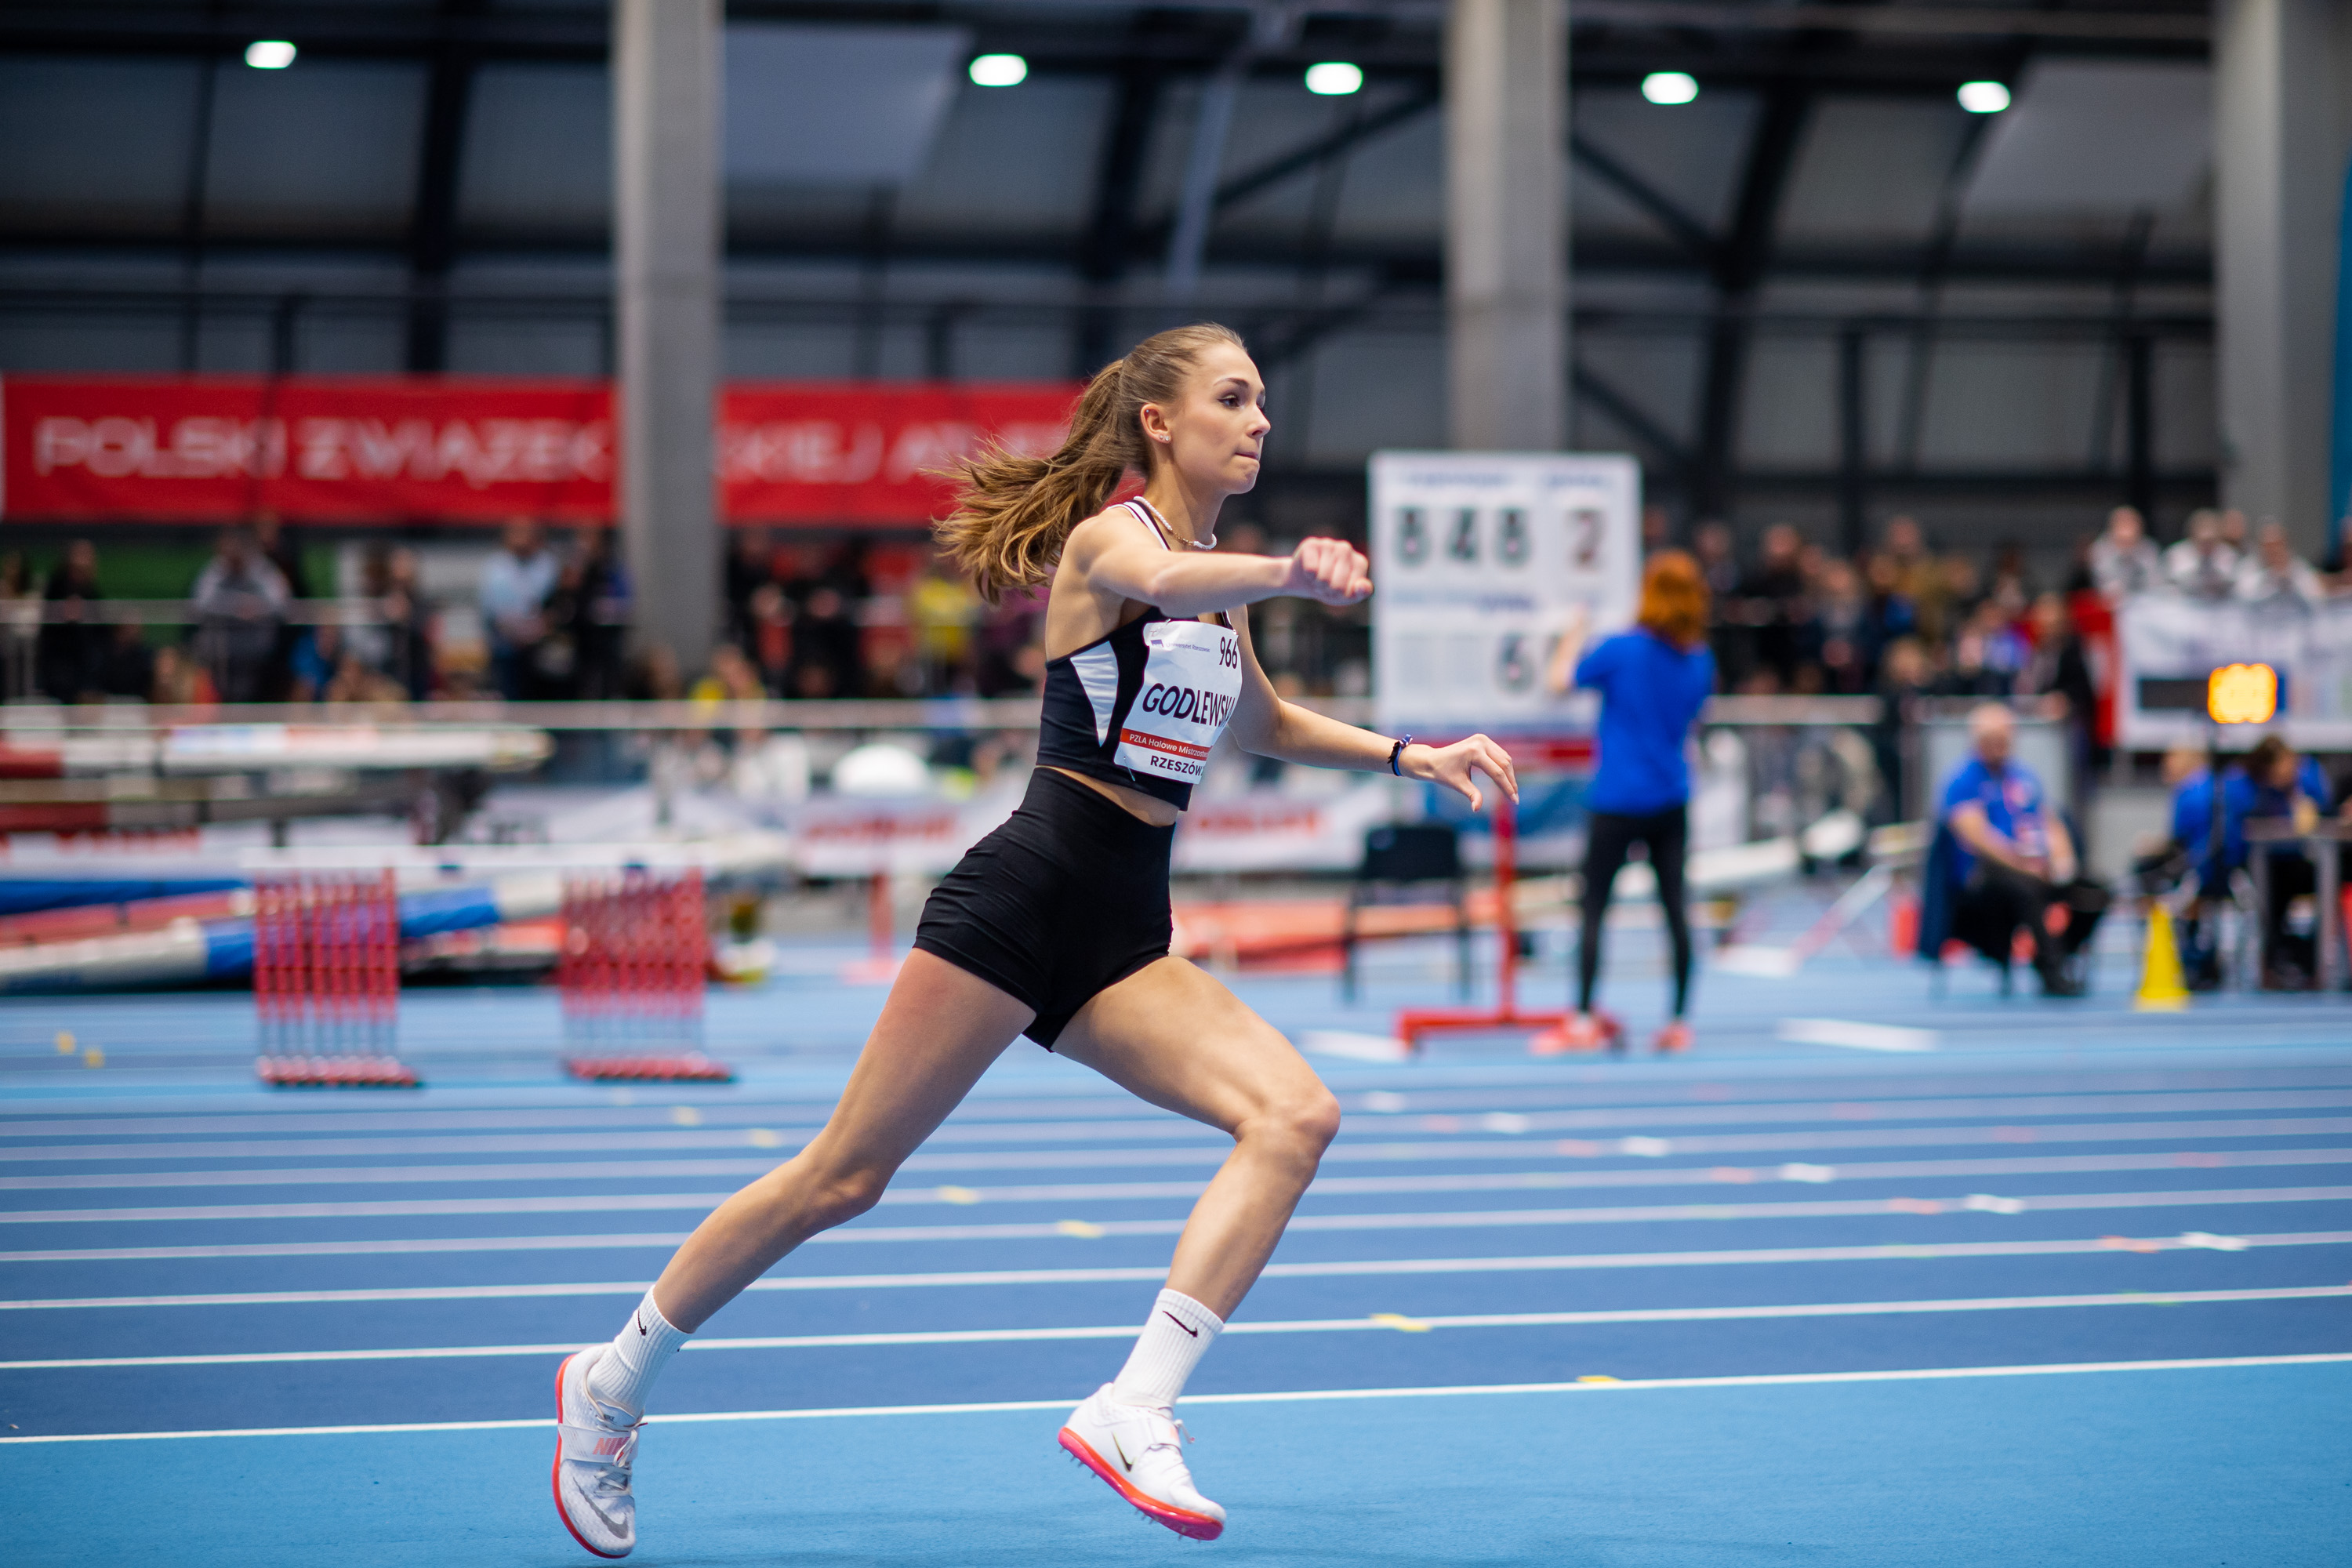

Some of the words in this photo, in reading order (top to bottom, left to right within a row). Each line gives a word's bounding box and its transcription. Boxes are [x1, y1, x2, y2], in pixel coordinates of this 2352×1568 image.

[34, 416, 287, 478] POLSKI
[1219, 637, 1237, 669] 966
[1129, 734, 1147, 745] PZLA
[1149, 739, 1178, 752] Halowe
[1150, 755, 1203, 776] RZESZÓW
[592, 1437, 630, 1455] NIK
